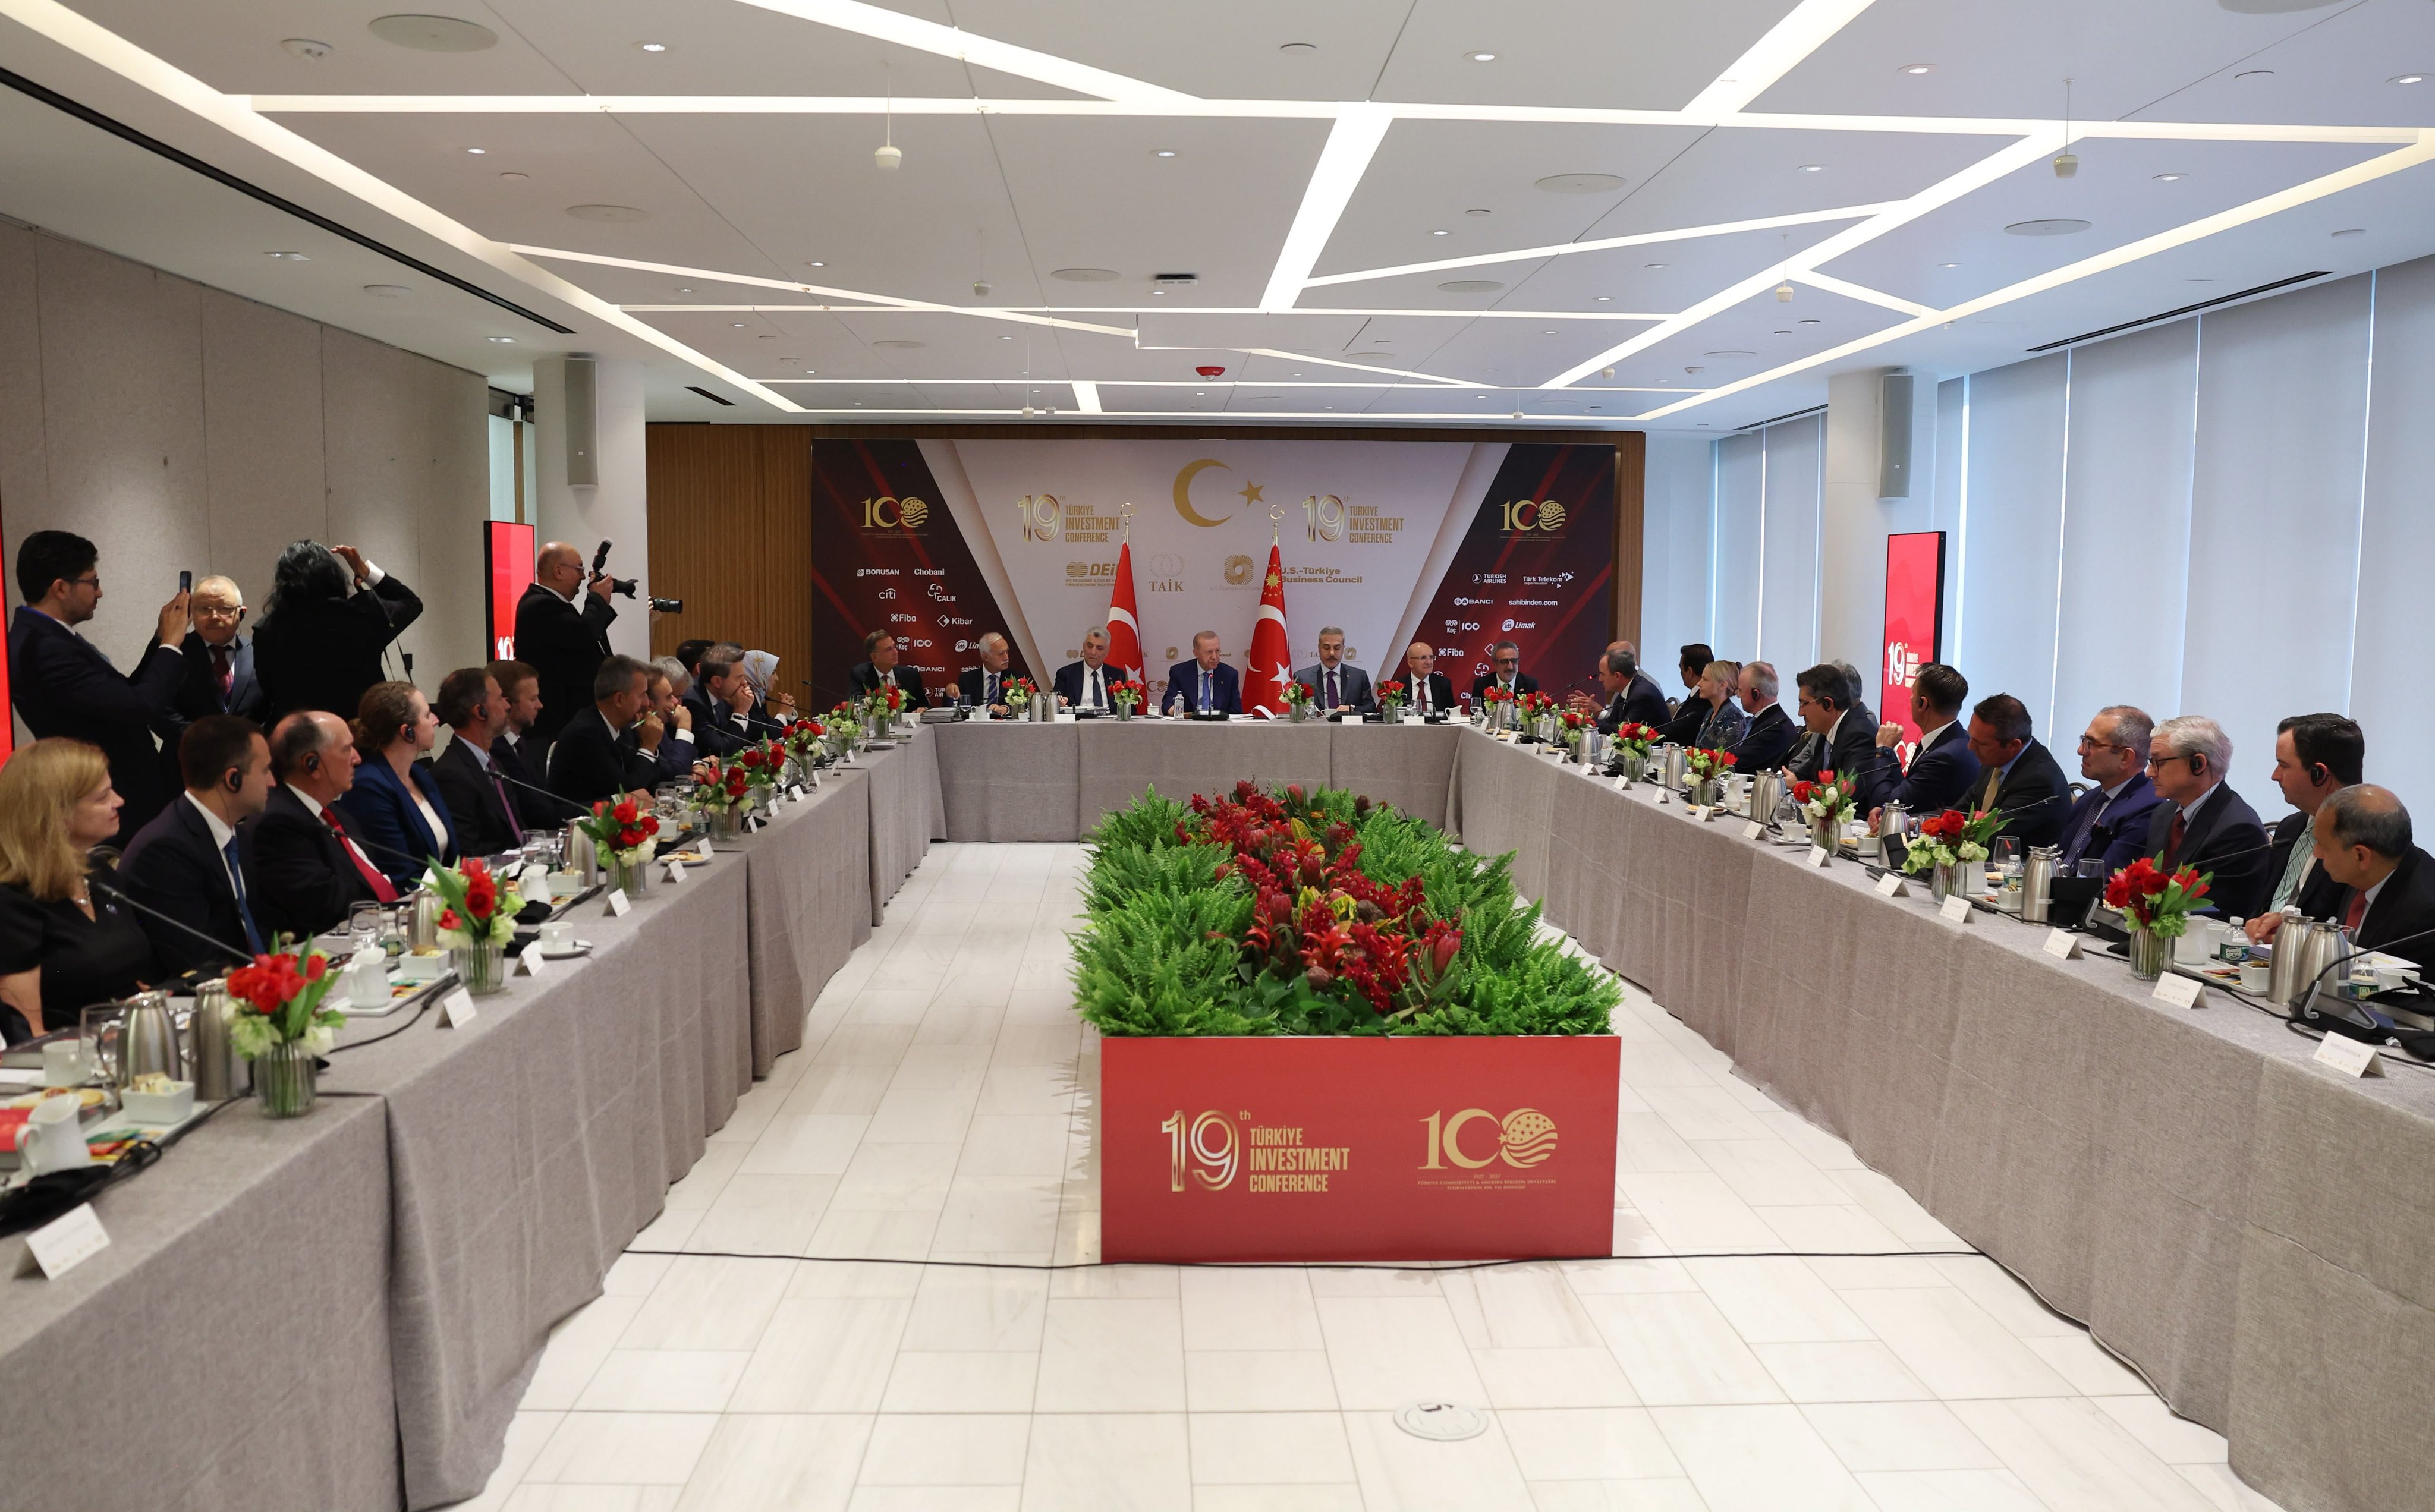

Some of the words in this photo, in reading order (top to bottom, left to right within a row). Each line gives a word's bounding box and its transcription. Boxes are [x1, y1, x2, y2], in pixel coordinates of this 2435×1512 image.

[1018, 494, 1061, 542] 19
[1065, 516, 1120, 530] INVESTMENT
[1302, 494, 1344, 542] 19
[1349, 518, 1404, 531] INVESTMENT
[1065, 532, 1109, 543] CONFERENCE
[1349, 533, 1393, 543] CONFERENCE
[1149, 579, 1184, 592] TAİK
[1326, 575, 1363, 584] Council
[879, 588, 896, 599] citi
[1454, 597, 1493, 606] SABANCI
[899, 613, 916, 622] Fiba
[1461, 622, 1480, 631] 100
[914, 639, 932, 648] 100
[1447, 648, 1464, 656] Fiba
[1888, 641, 1905, 685] 19
[1250, 1126, 1303, 1146] TÜRKİYE
[1161, 1110, 1239, 1192] 19
[1239, 1110, 1251, 1120] th
[1250, 1148, 1350, 1171] INVESTMENT
[1250, 1174, 1329, 1193] CONFERENCE
